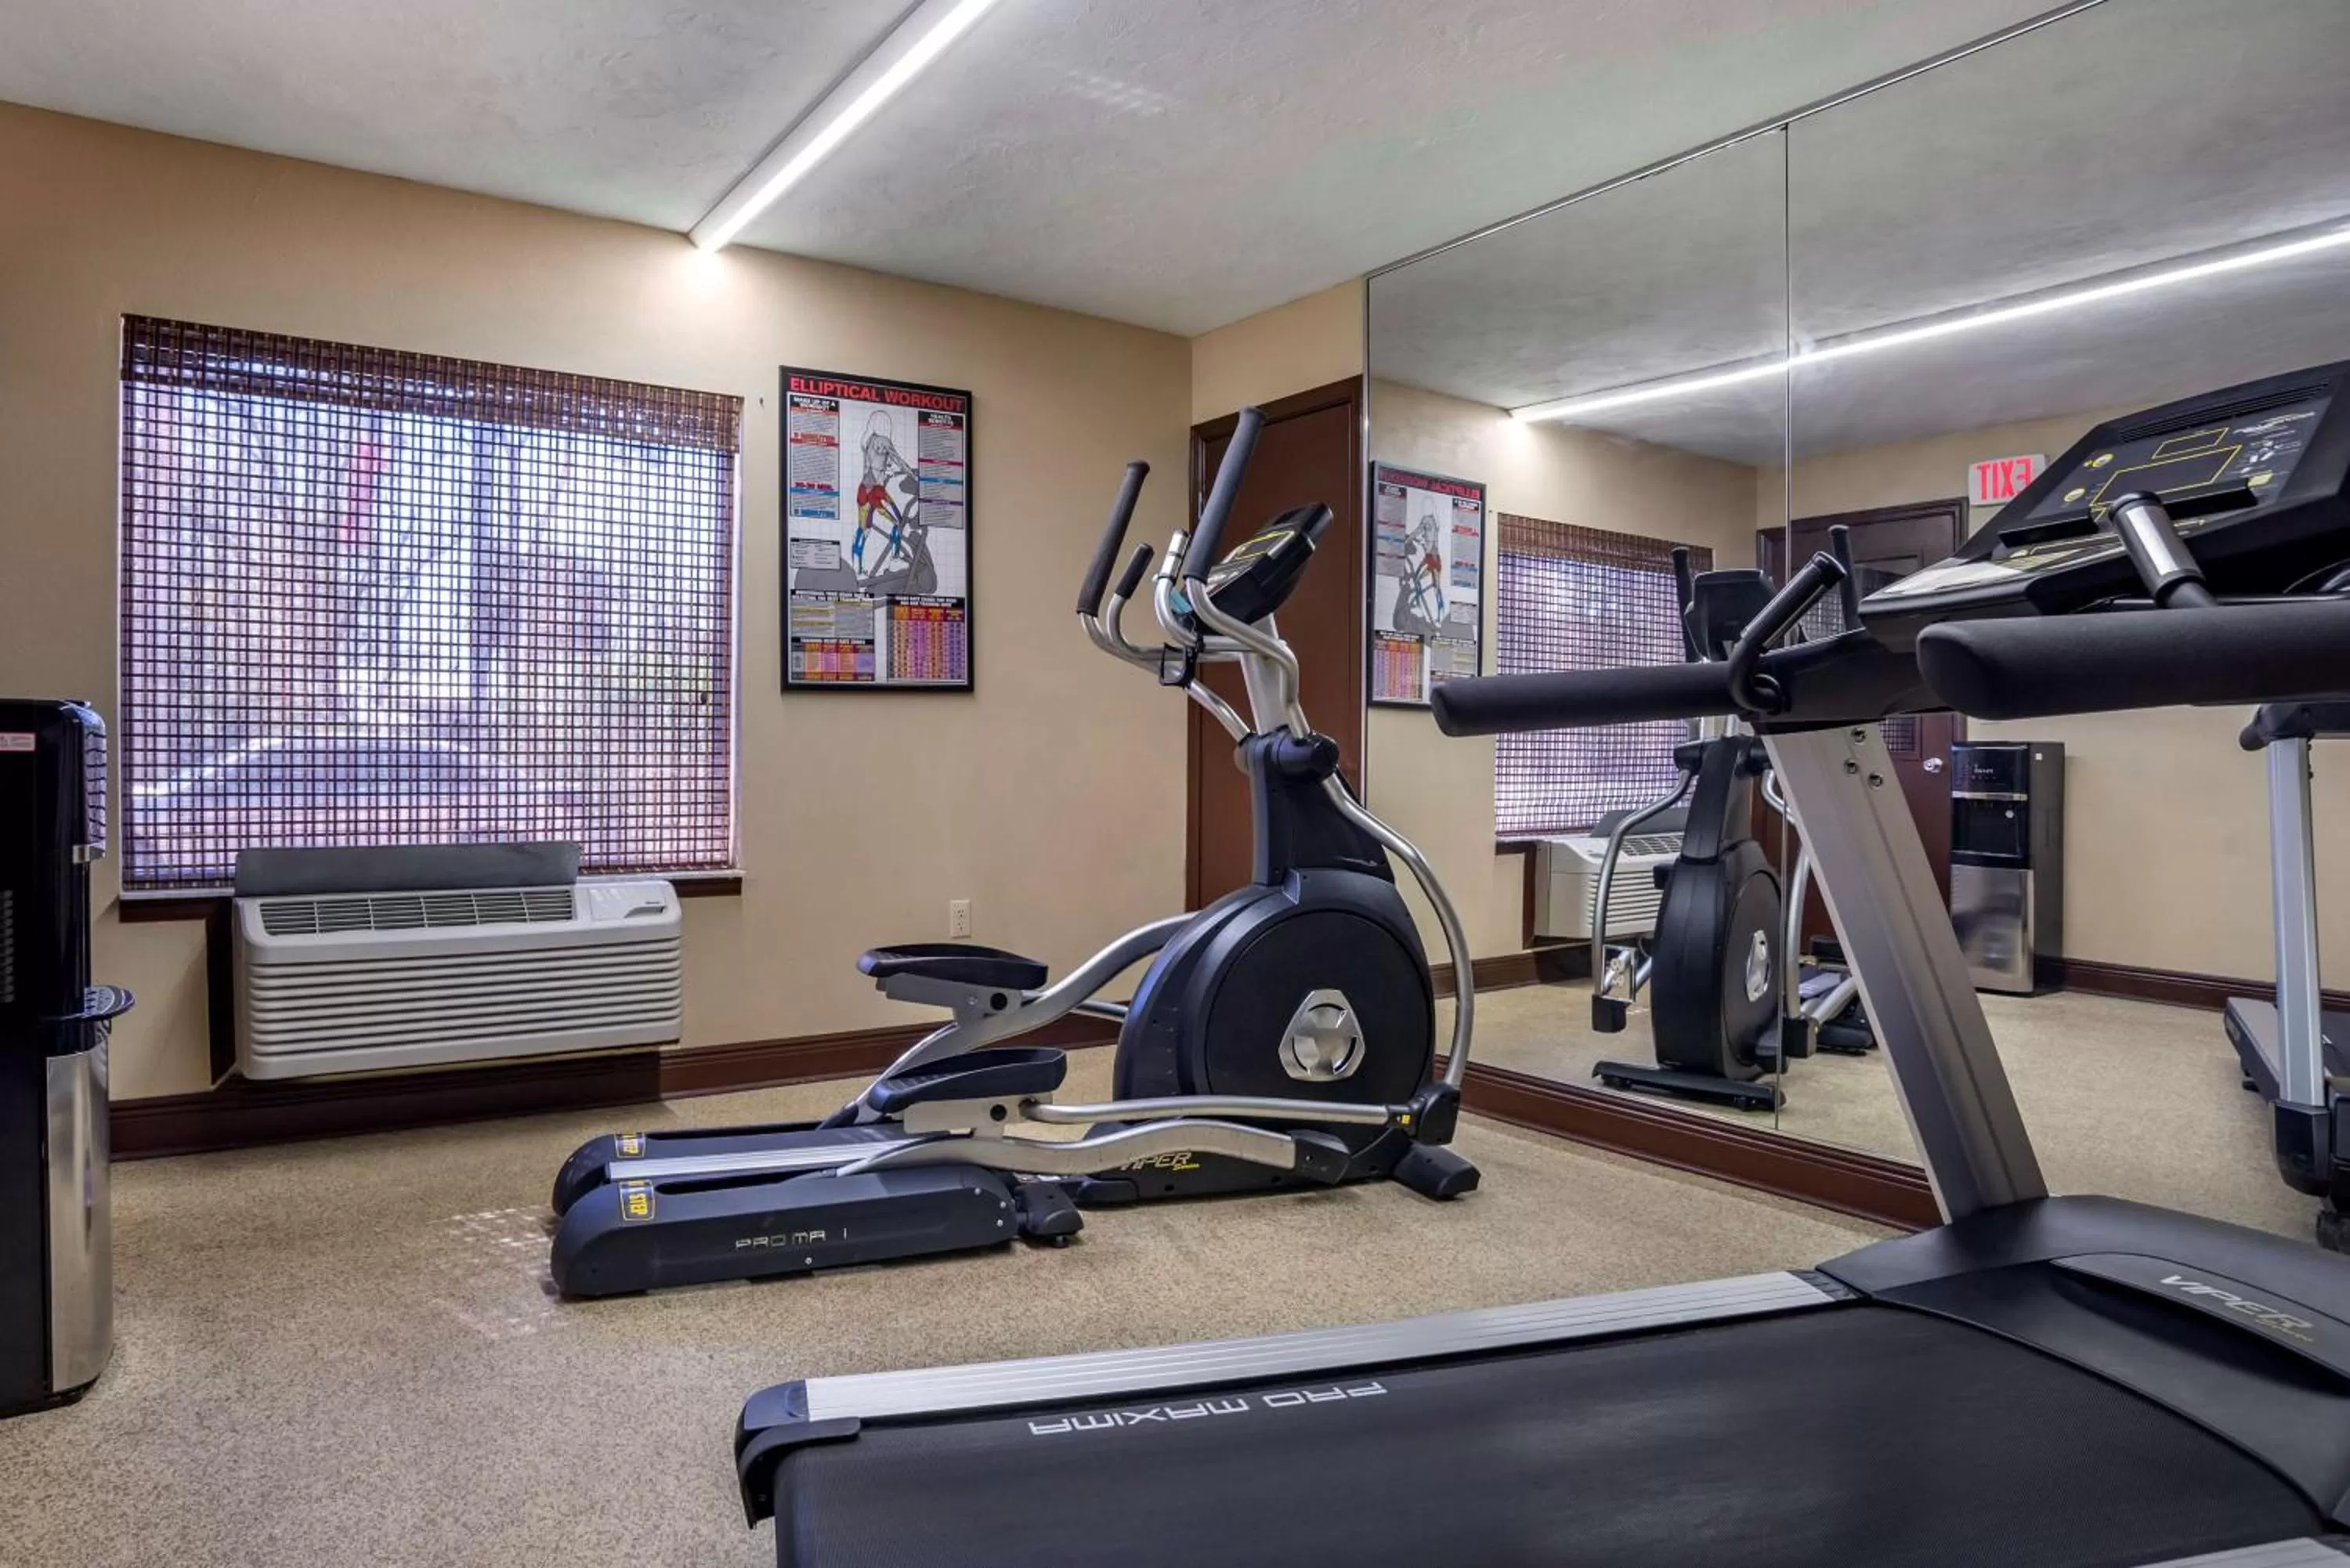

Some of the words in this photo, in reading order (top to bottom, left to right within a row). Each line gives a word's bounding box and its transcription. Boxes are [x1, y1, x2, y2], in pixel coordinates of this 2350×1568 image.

[790, 377, 880, 401] ELLIPTICAL
[884, 389, 962, 411] WORKOUT
[736, 1235, 786, 1249] PRO
[2160, 1274, 2315, 1328] VIPER
[1262, 1381, 1388, 1407] PRO
[1028, 1398, 1249, 1435] MAXIMA
